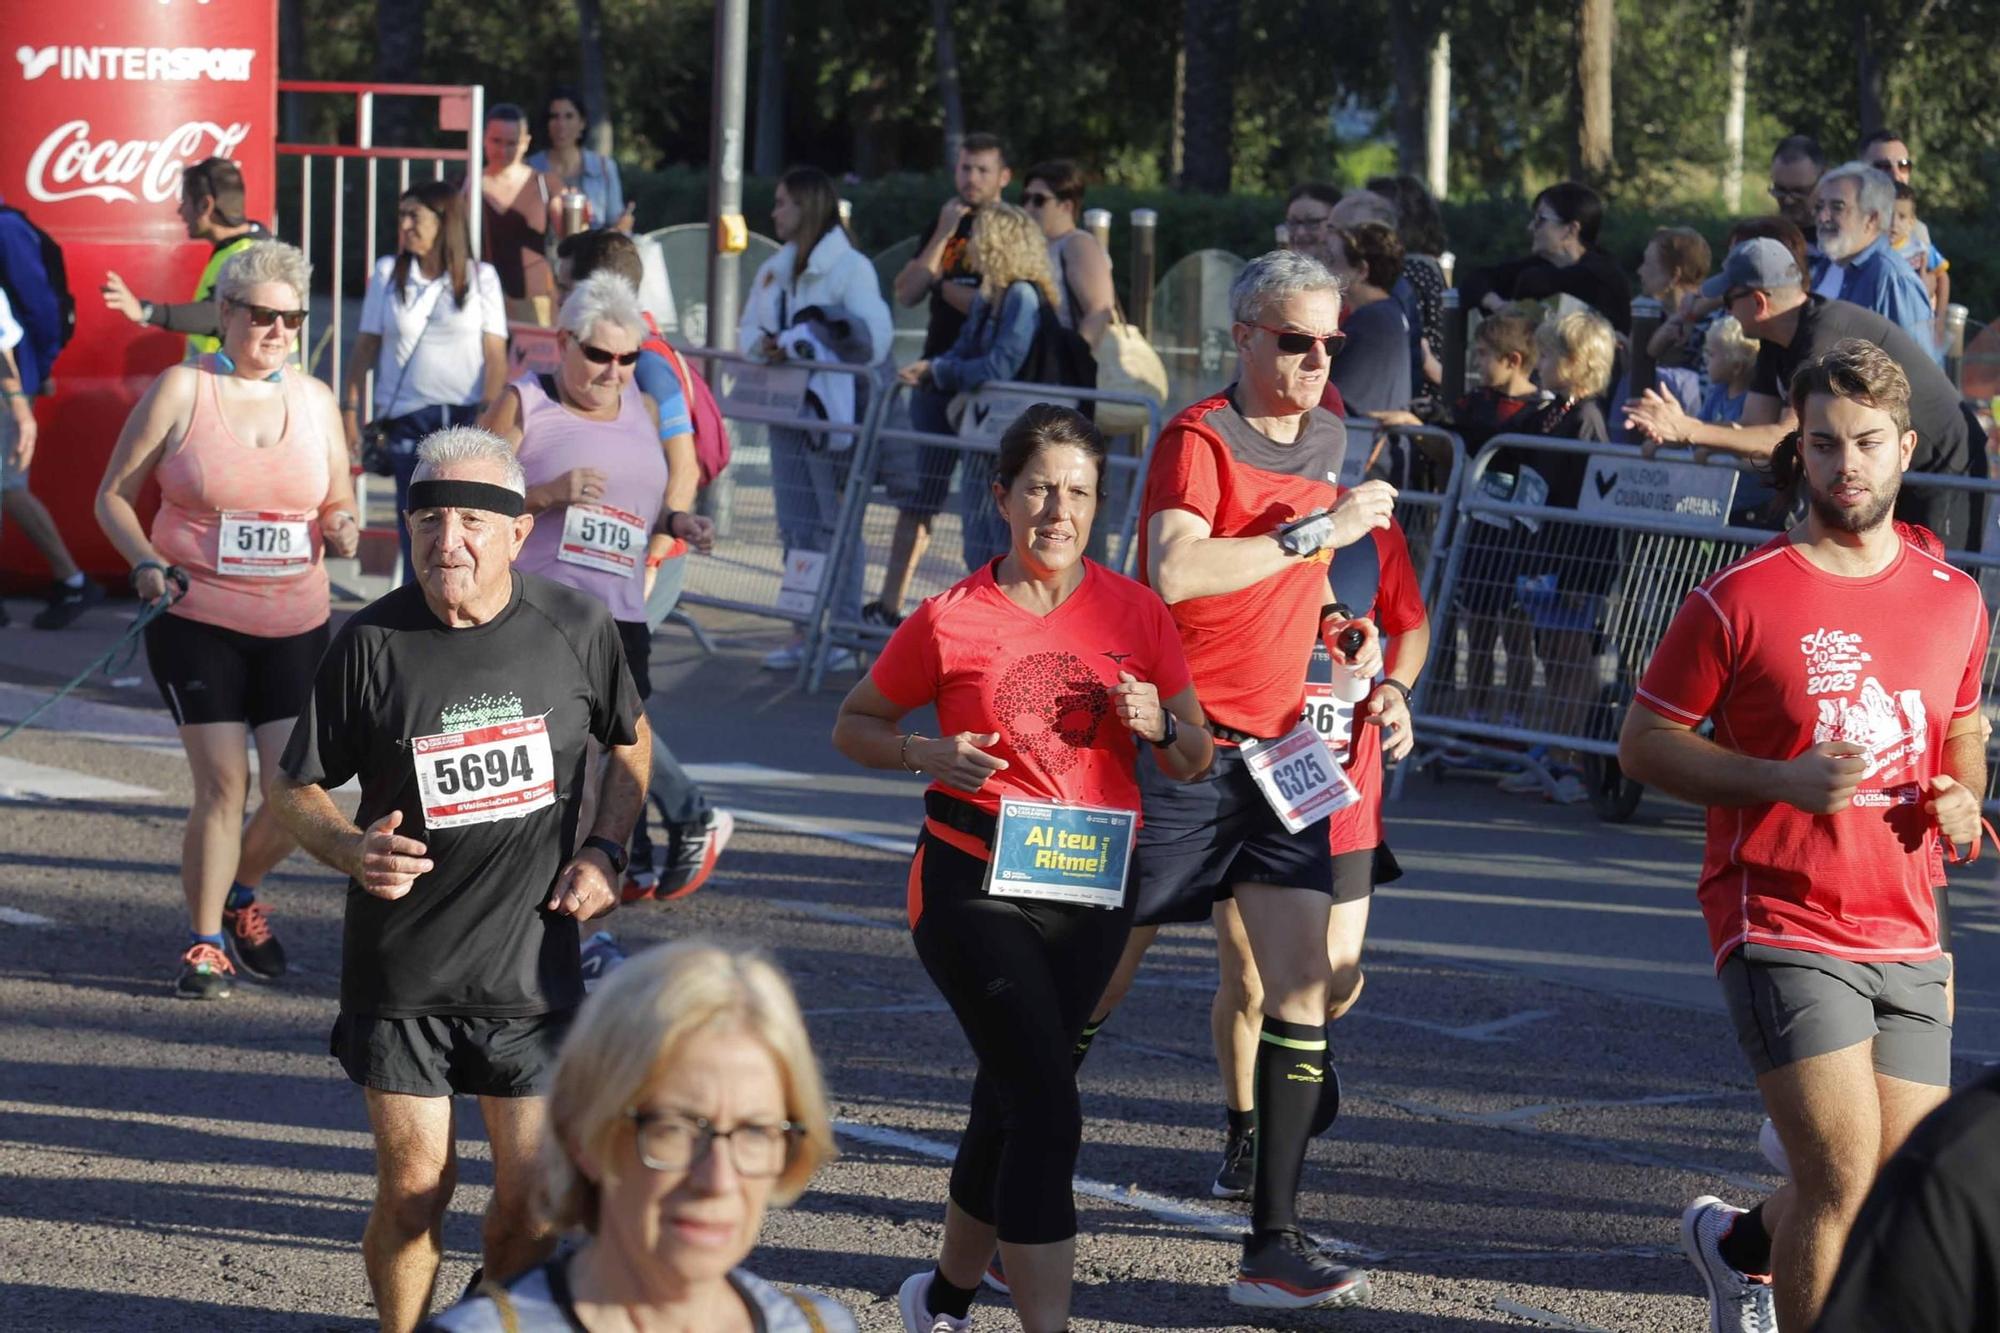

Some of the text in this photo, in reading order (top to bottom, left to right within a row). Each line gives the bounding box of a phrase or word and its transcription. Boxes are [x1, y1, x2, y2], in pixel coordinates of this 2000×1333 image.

[26, 119, 251, 204] Coca-C
[237, 525, 291, 553] 5178
[581, 516, 631, 552] 5179
[1806, 672, 1857, 695] 2023
[434, 745, 534, 795] 5694
[1272, 752, 1328, 801] 6325
[1024, 825, 1097, 851] Al teu
[1034, 850, 1099, 873] Ritme
